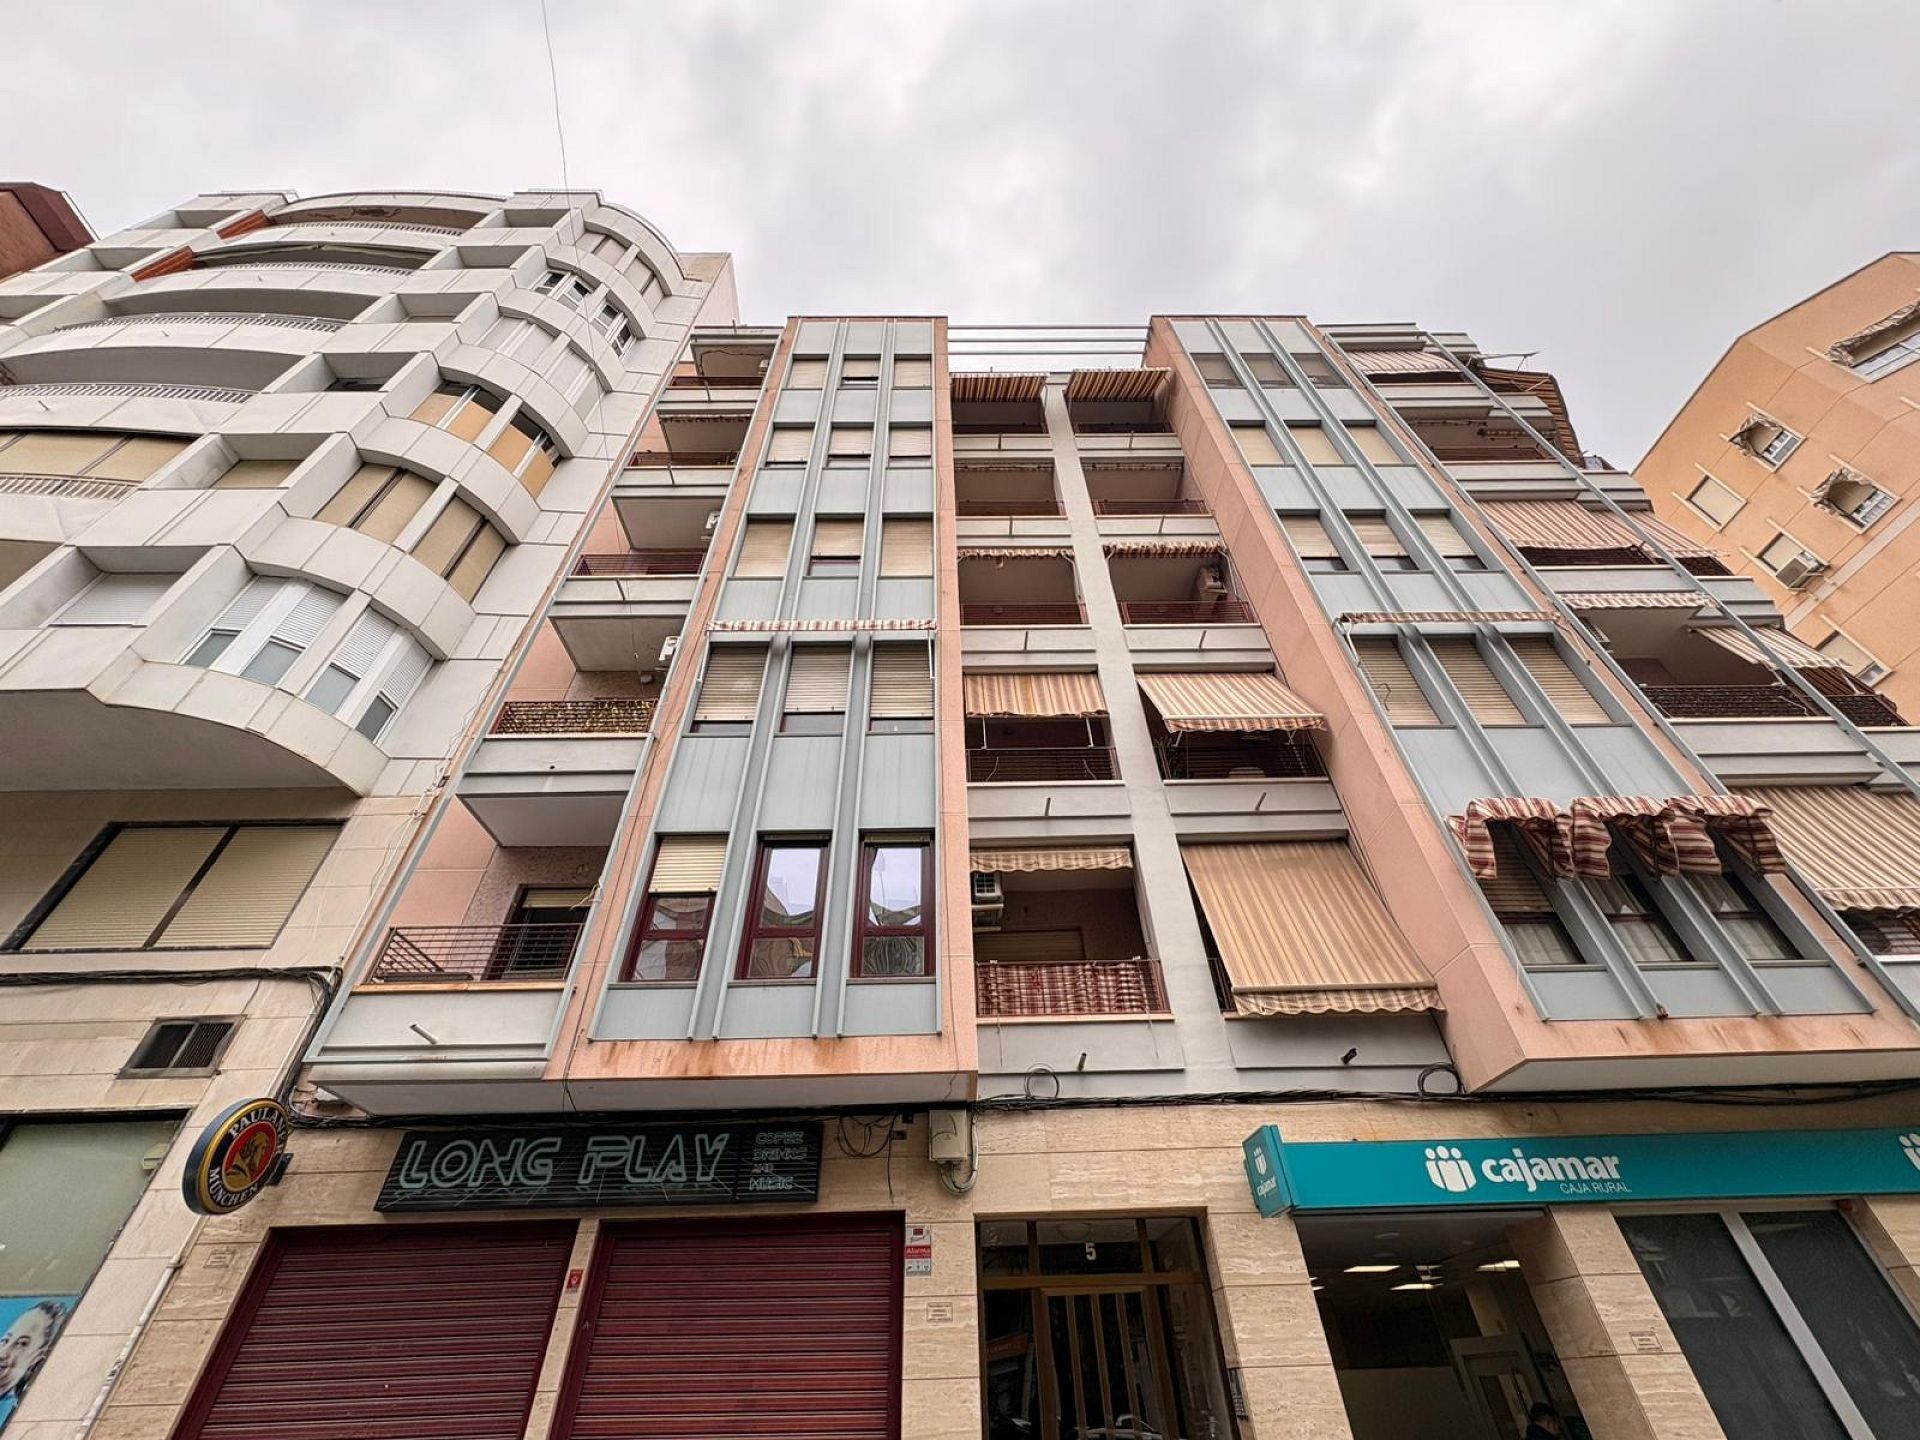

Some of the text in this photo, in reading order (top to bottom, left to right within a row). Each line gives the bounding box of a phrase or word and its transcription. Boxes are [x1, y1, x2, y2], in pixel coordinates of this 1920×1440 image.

[400, 1133, 730, 1188] LONG PLAY
[1481, 1148, 1622, 1193] cajamar
[1559, 1180, 1632, 1194] CAJA RURAL
[1085, 1242, 1097, 1261] 5
